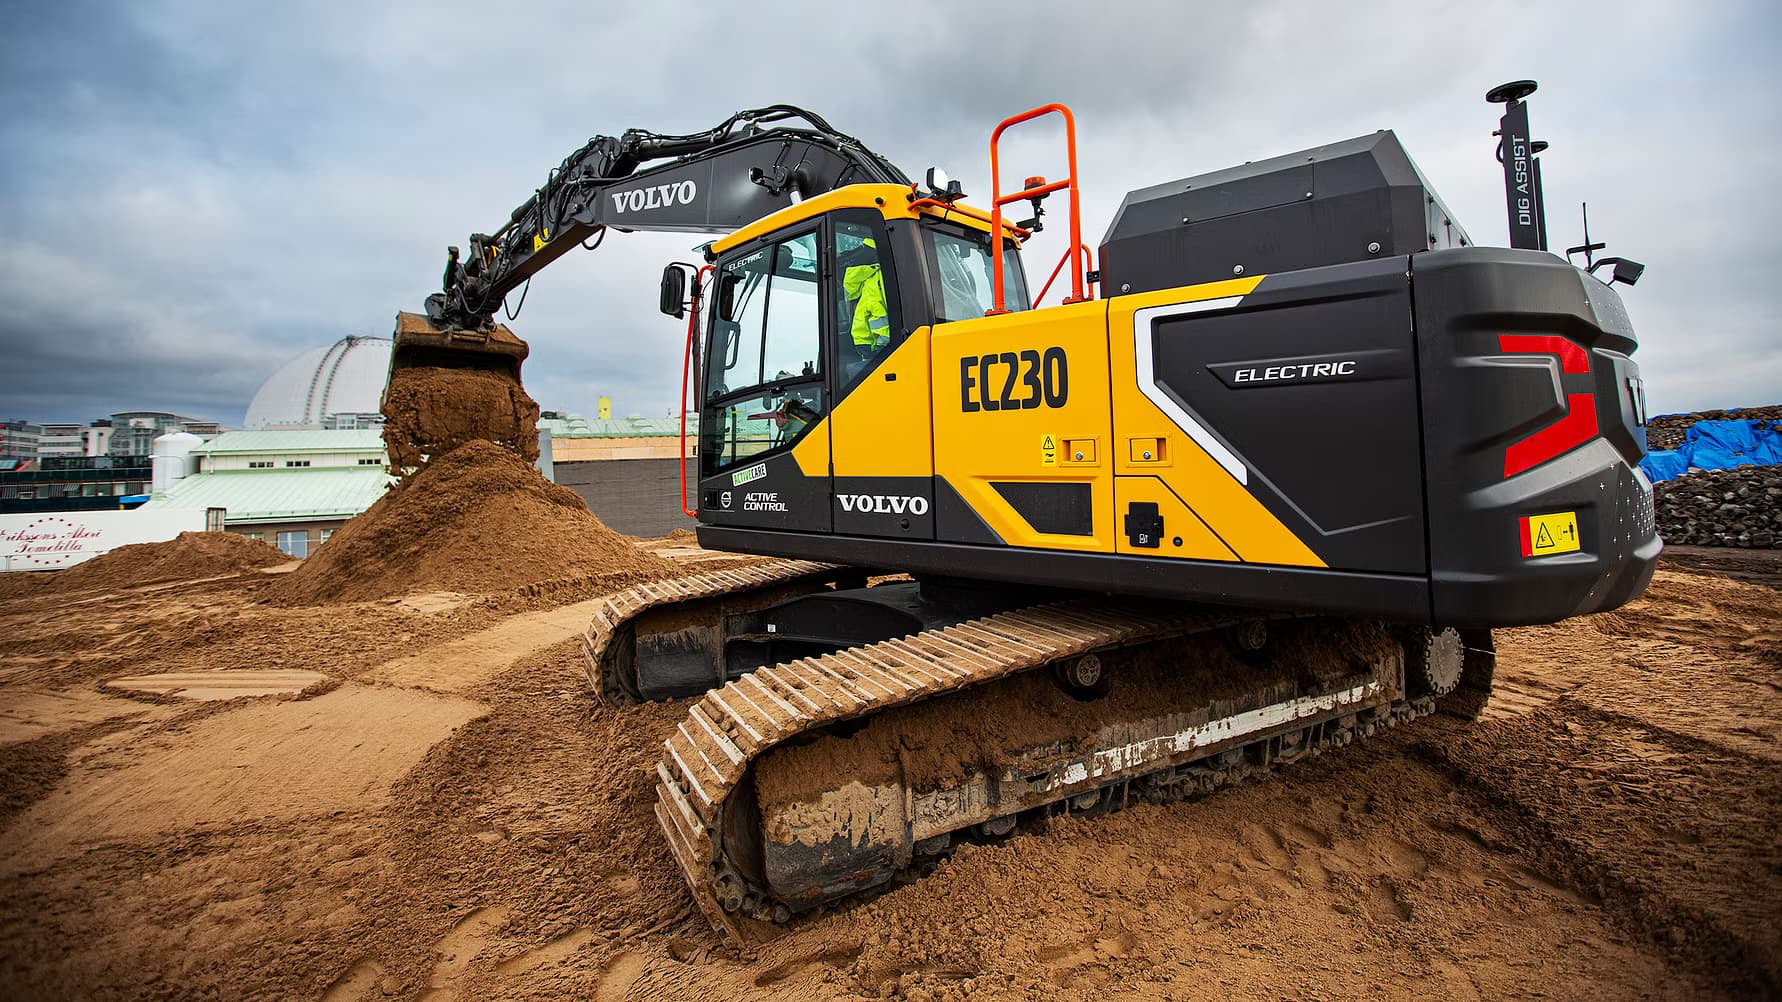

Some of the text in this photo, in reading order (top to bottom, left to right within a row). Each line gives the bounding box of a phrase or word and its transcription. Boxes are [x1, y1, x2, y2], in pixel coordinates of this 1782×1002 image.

[1512, 135, 1531, 225] DIG ASSIST
[611, 180, 697, 214] VOLVO
[728, 251, 764, 272] ELECTRIC
[960, 346, 1069, 413] EC230
[1233, 360, 1356, 383] ELECTRIC
[743, 502, 789, 512] CONTROL
[744, 492, 778, 502] ACTIVE
[836, 494, 929, 516] VOLVO
[15, 540, 83, 554] Tomelilla
